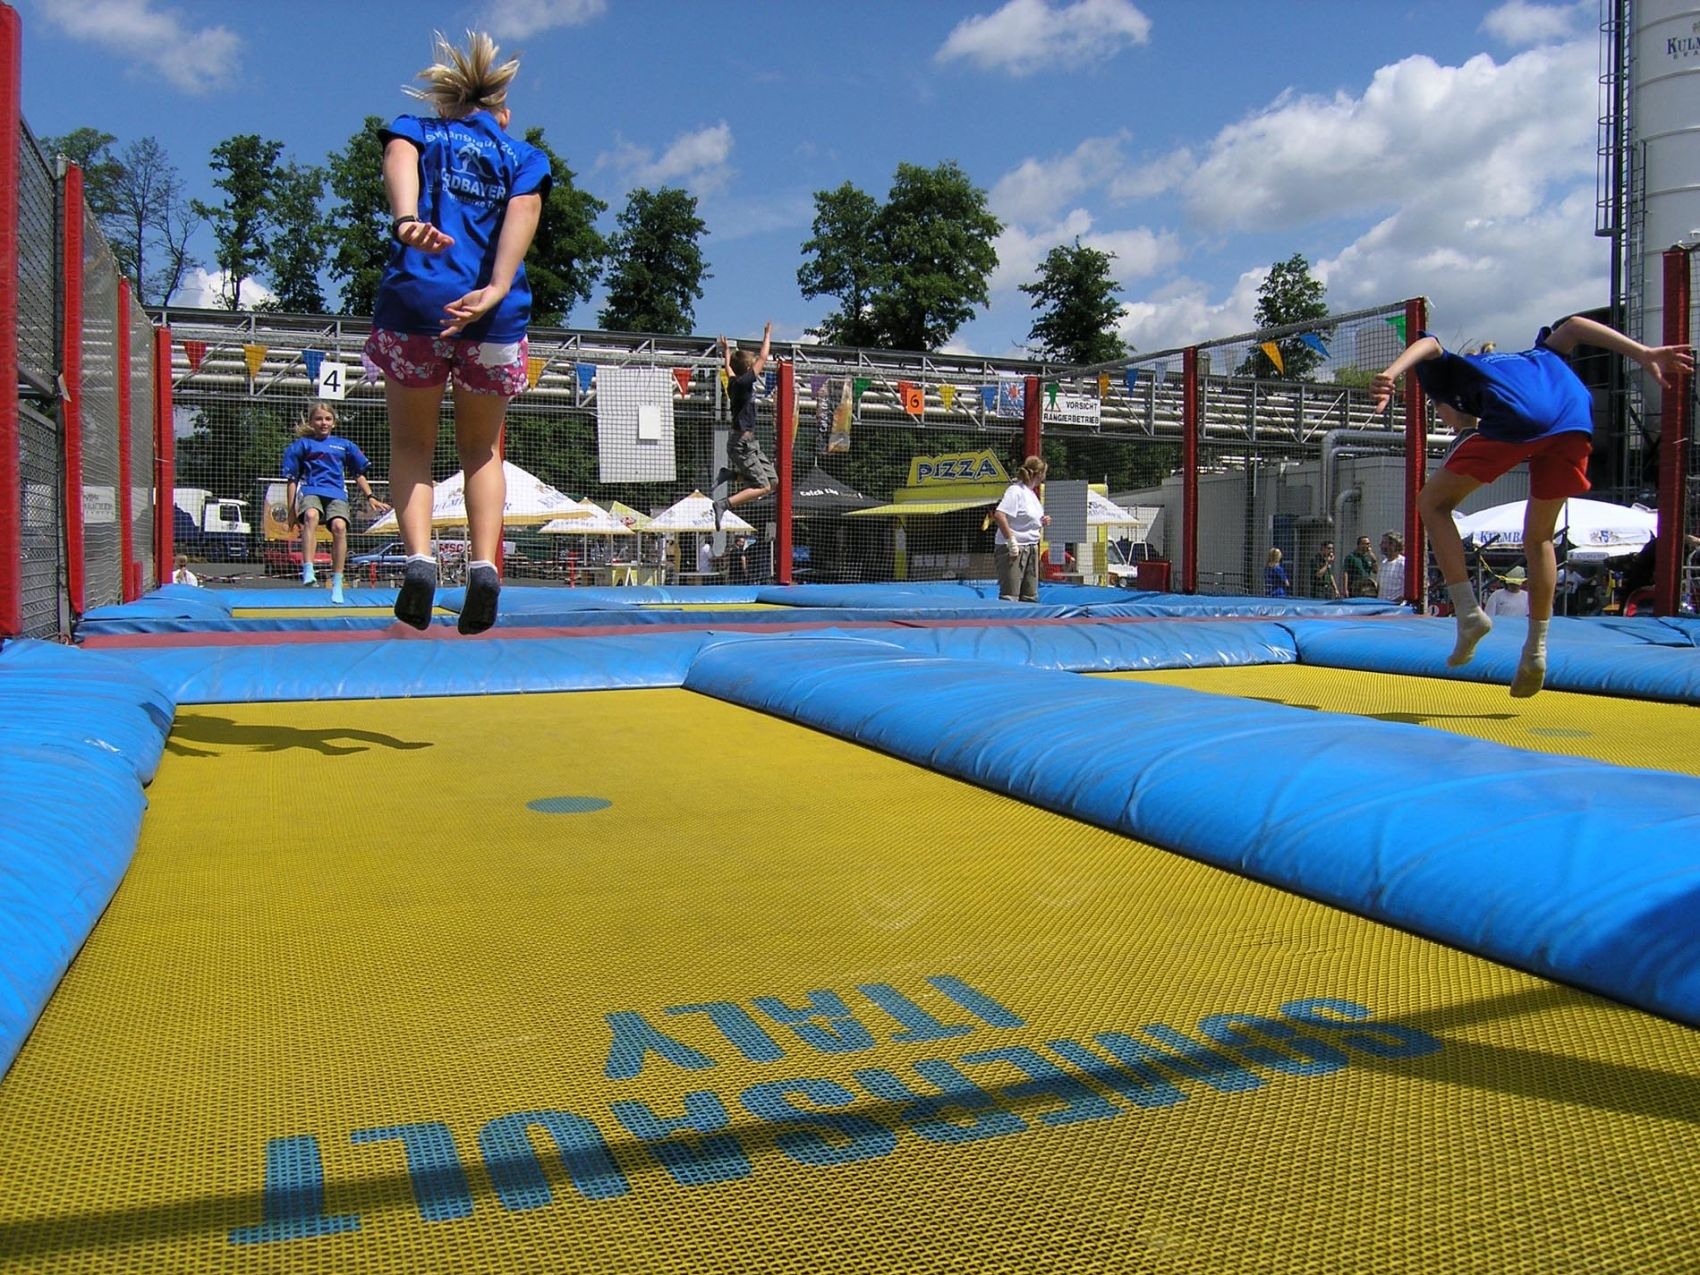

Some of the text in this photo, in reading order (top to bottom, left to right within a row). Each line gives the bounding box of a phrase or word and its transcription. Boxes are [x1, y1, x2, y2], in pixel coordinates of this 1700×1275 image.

[323, 370, 341, 392] 4
[910, 394, 920, 408] 6
[1066, 401, 1098, 411] VORSICHT
[1043, 413, 1099, 425] RANGIERBETRIEB
[917, 458, 998, 482] PIZZA
[605, 975, 1027, 1079] ITALY
[229, 998, 1443, 1244] SOMERSAULT
